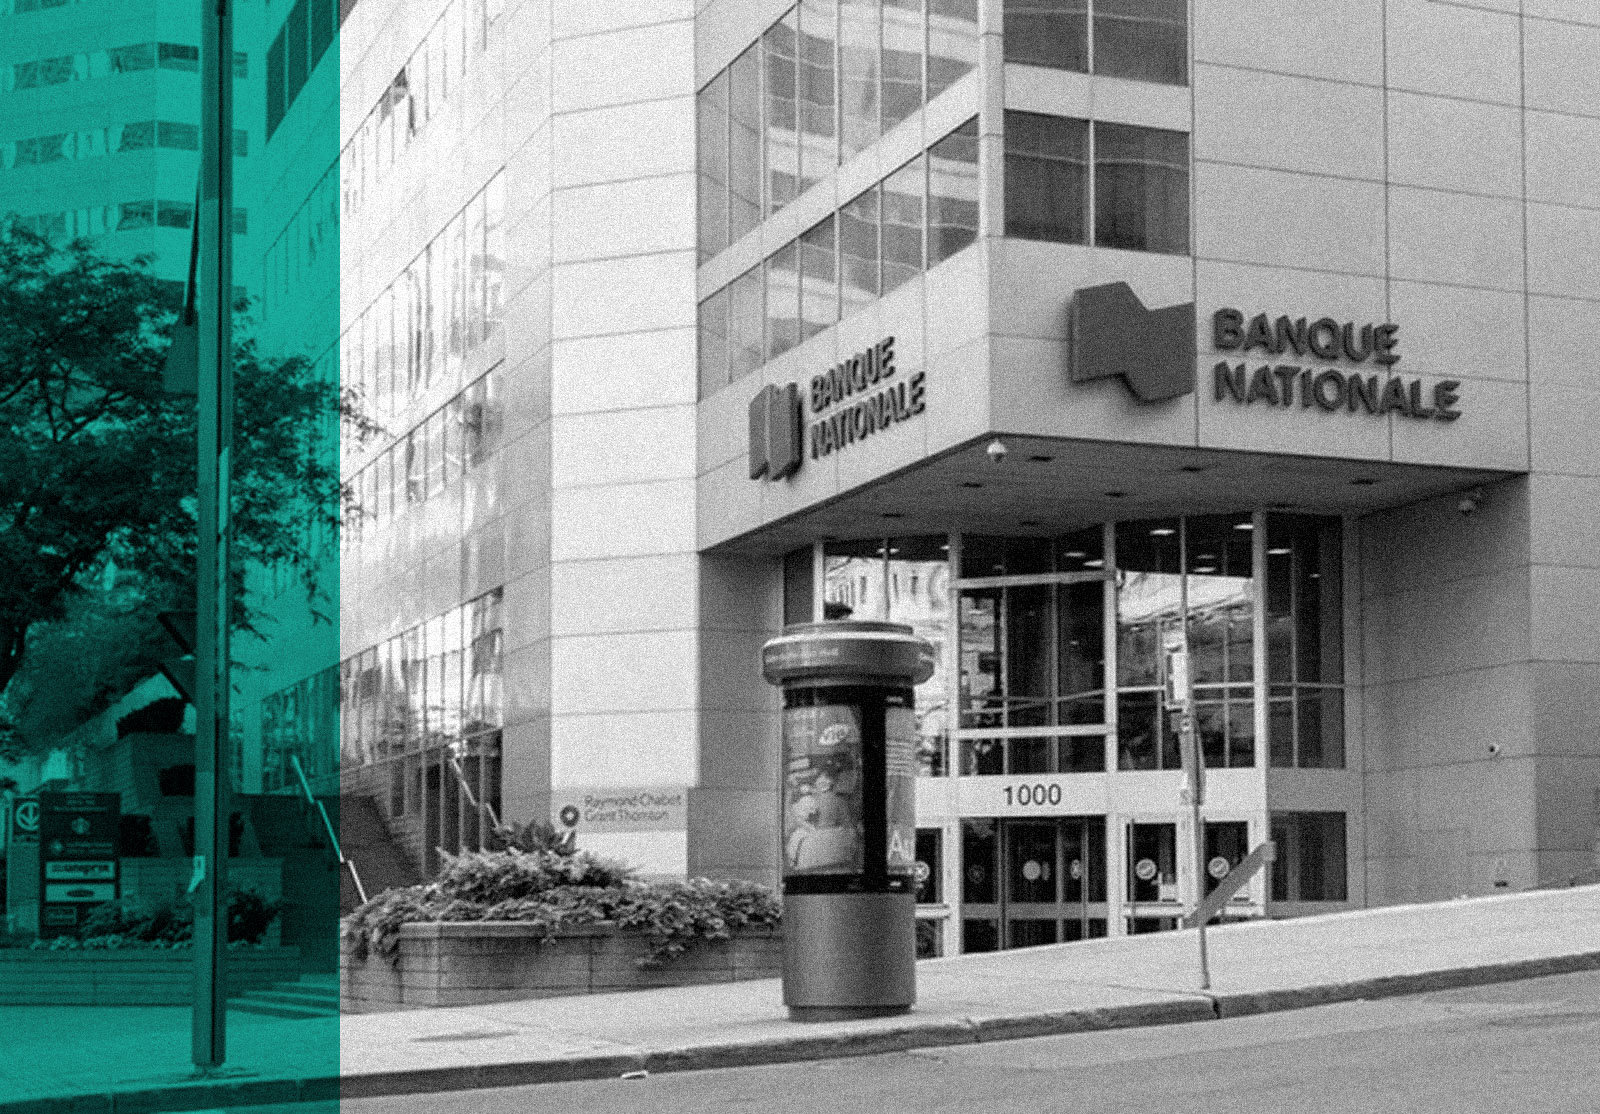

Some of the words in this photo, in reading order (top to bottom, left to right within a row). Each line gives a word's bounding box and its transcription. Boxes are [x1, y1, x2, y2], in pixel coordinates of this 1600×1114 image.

[1213, 307, 1401, 366] BANQUE
[811, 336, 896, 413] BANQUE
[1213, 360, 1462, 422] NATIONALE
[811, 371, 926, 460] NATIONALE
[584, 795, 637, 809] Raymond
[639, 793, 681, 807] Chabot
[584, 809, 616, 822] Grant
[1003, 783, 1062, 806] 1000
